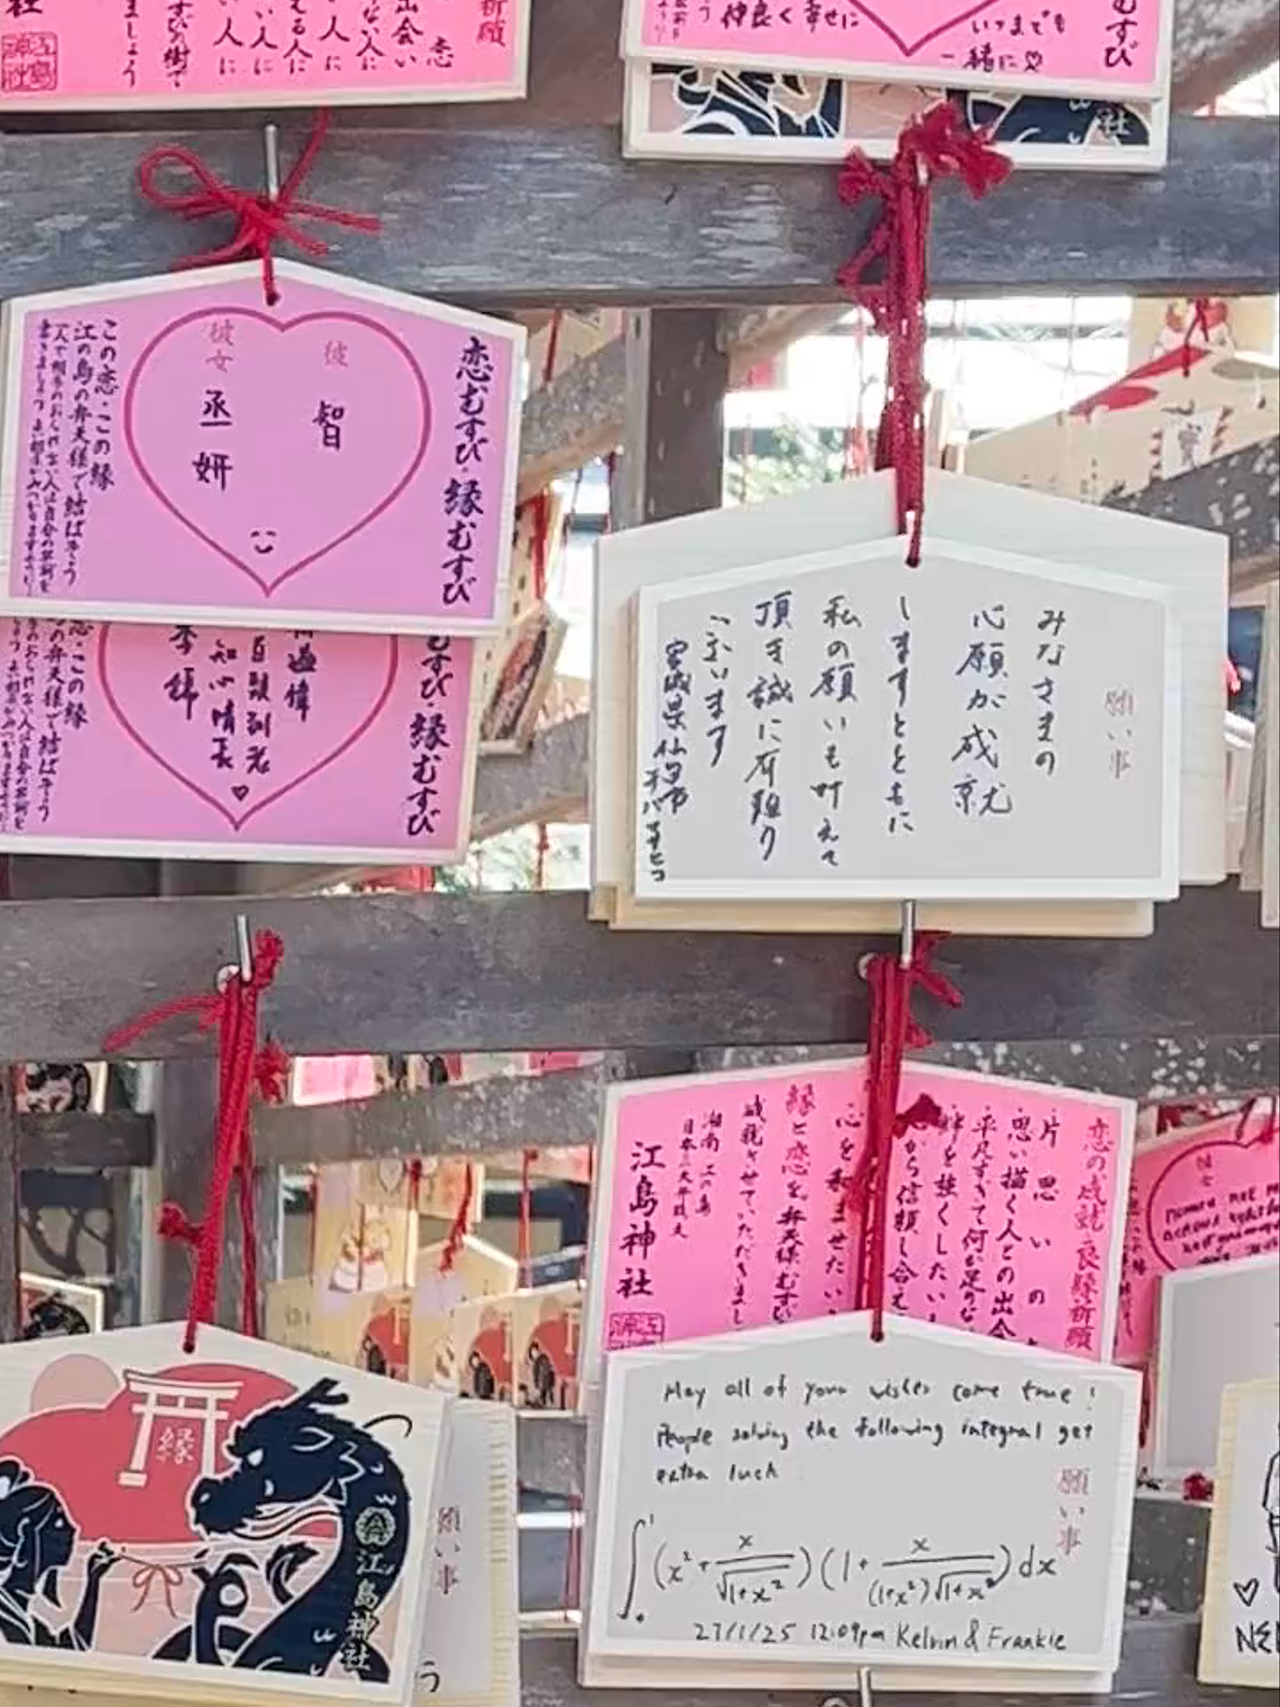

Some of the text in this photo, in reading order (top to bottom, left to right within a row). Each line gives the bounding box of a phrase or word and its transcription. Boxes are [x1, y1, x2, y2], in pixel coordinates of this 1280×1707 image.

[618, 1141, 667, 1299] 江島神社
[156, 1427, 197, 1463] 縁
[341, 1551, 394, 1671] 江島神社
